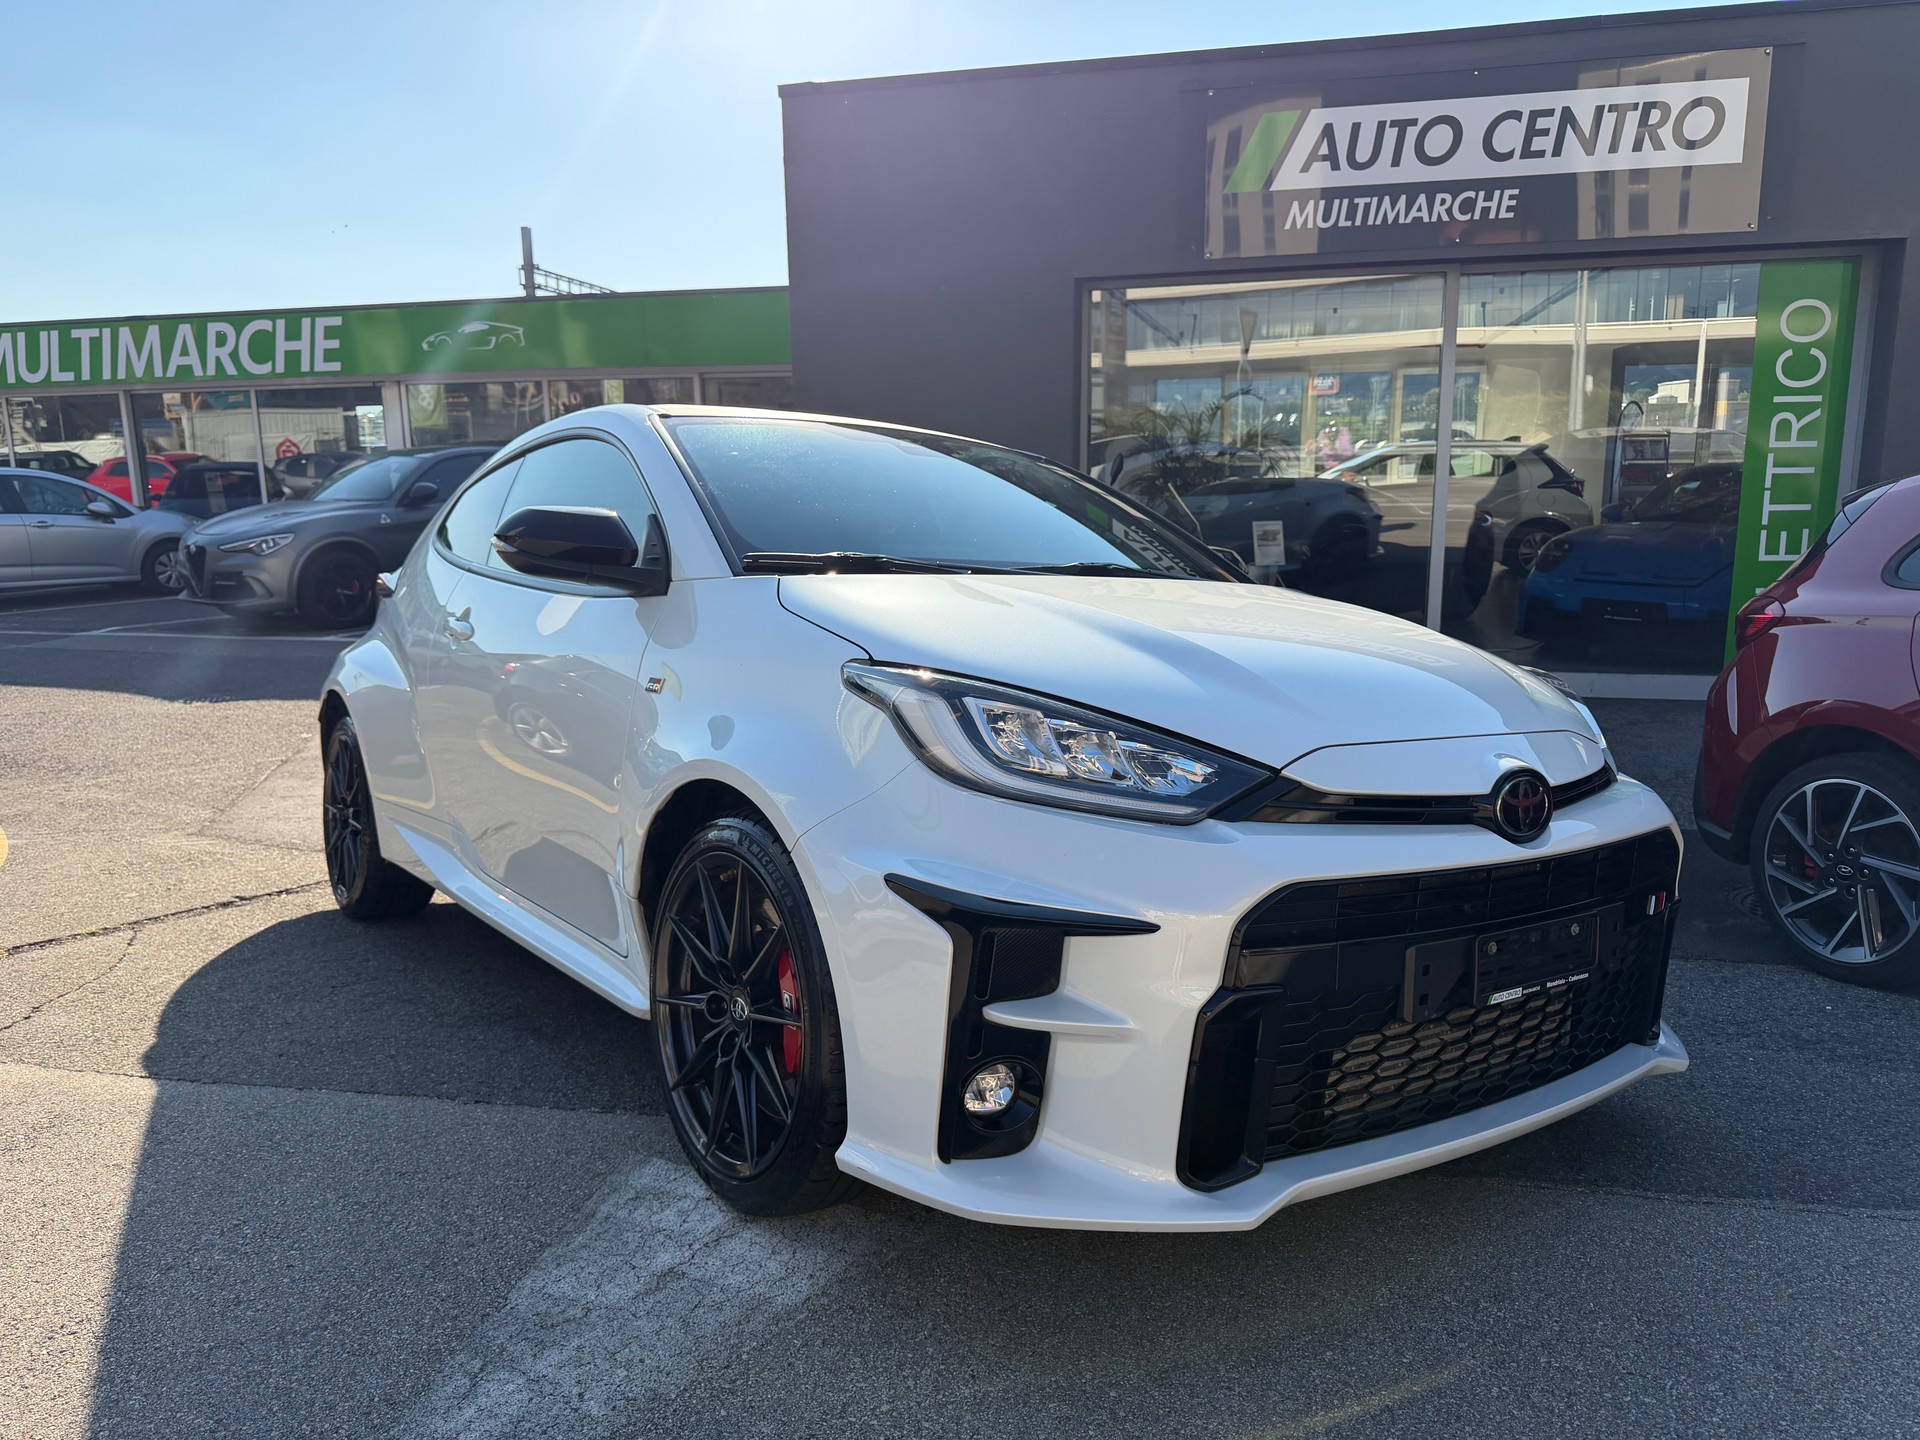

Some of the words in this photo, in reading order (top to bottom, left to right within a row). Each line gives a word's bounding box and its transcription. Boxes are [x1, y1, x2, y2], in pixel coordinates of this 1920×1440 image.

[1299, 114, 1463, 174] AUTO
[1481, 96, 1727, 163] CENTRO
[1284, 188, 1520, 230] MULTIMARCHE
[1755, 298, 1832, 594] ETTRICO
[750, 843, 794, 907] MICHELIN
[1492, 993, 1505, 1003] AUTO
[1504, 989, 1521, 1000] CENTRO
